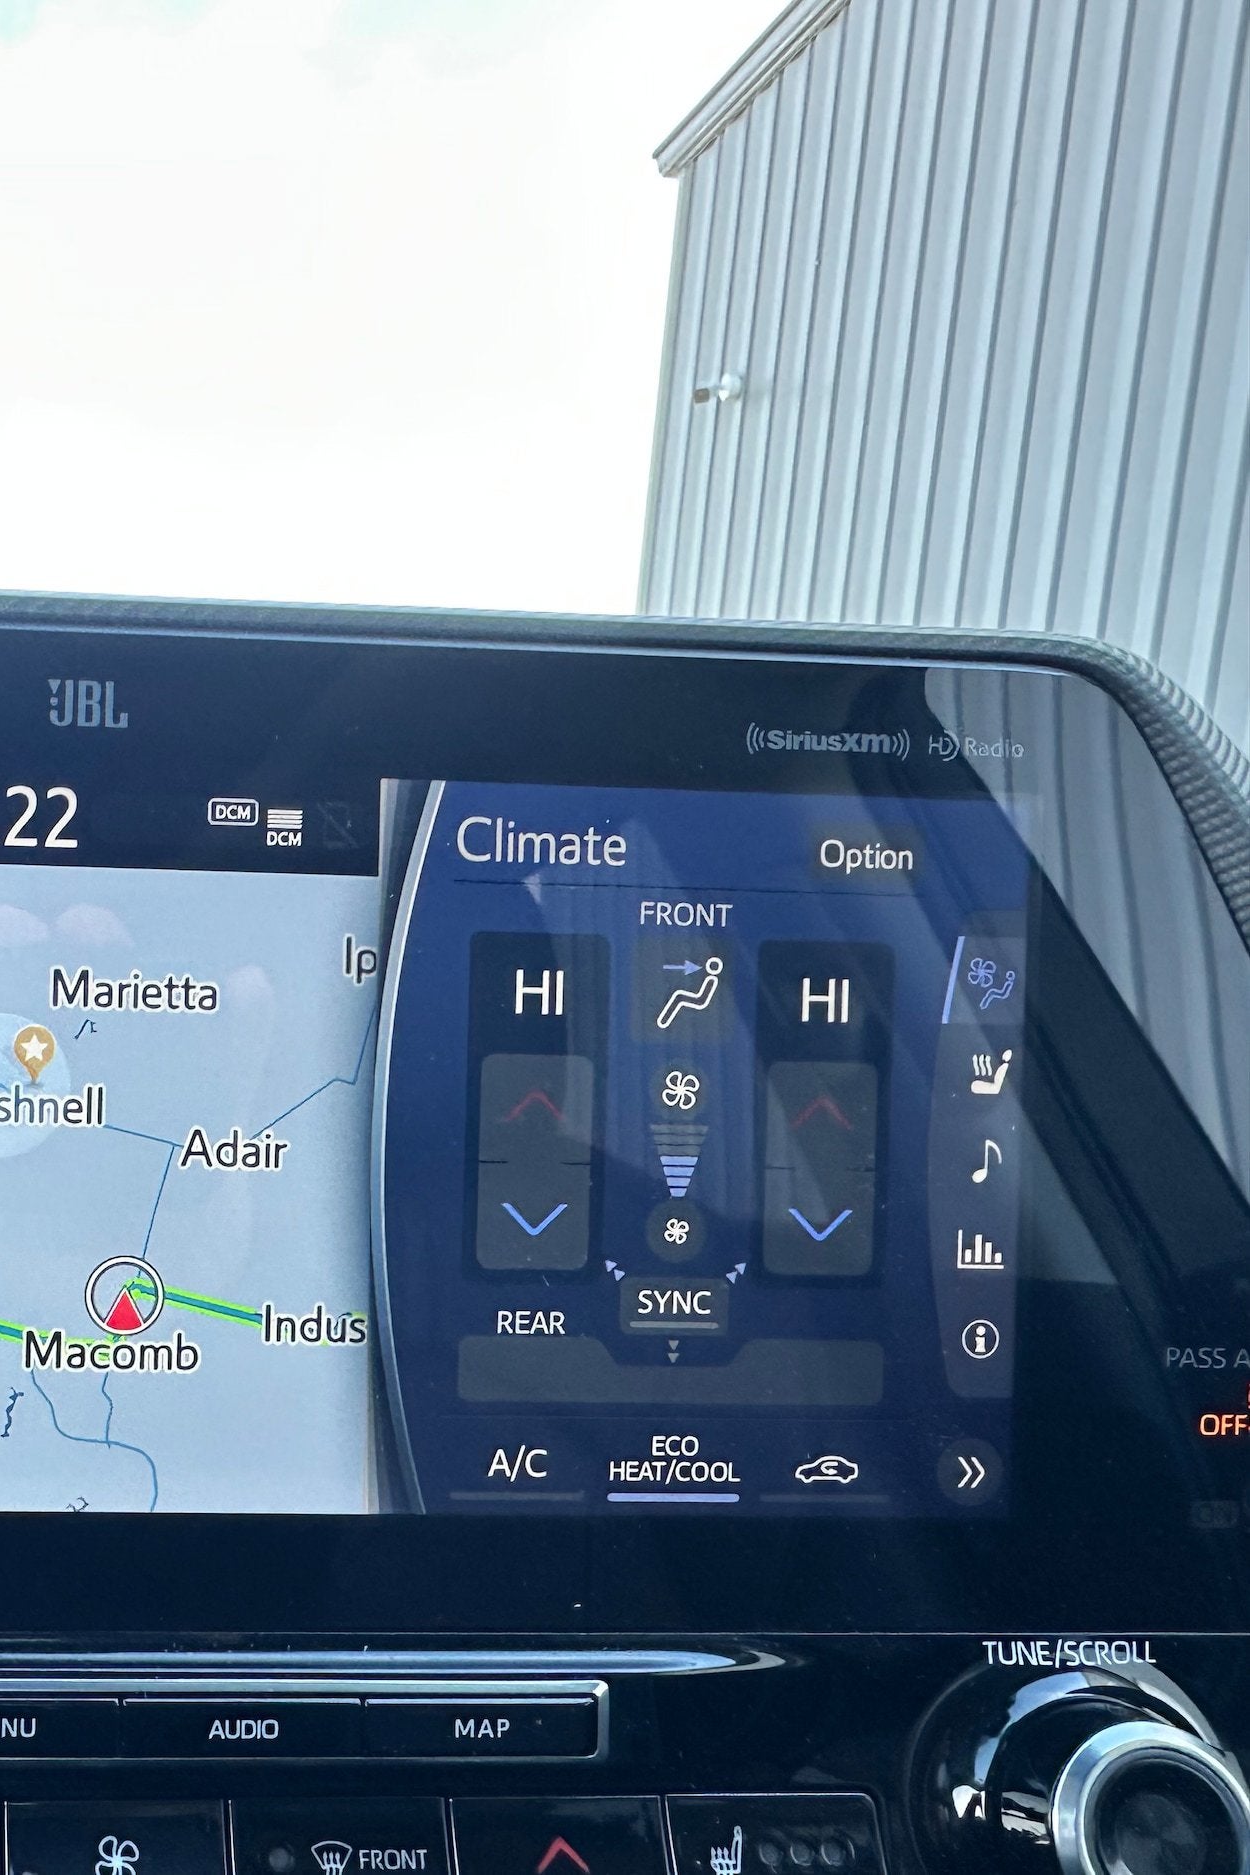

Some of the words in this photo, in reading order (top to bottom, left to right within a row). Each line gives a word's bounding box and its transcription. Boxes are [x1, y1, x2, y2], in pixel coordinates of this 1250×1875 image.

[48, 679, 128, 728] JBL
[966, 737, 1024, 757] Radio
[216, 805, 250, 819] DCM
[267, 831, 301, 846] DCM
[457, 817, 626, 866] Climate
[821, 840, 912, 874] Option
[641, 902, 733, 926] FRONT
[53, 969, 216, 1010] Marietta
[516, 970, 564, 1015] HI
[802, 978, 849, 1023] HI
[180, 1129, 287, 1169] Adair
[638, 1290, 711, 1314] SYNC
[265, 1304, 366, 1342] Indus
[498, 1311, 565, 1334] REAR
[25, 1331, 199, 1370] Macomb
[1166, 1347, 1226, 1369] PASS
[1200, 1415, 1247, 1435] OFF
[652, 1436, 698, 1456] ECO
[488, 1445, 547, 1482] A/C
[610, 1459, 740, 1484] HEAT/COOL
[982, 1639, 1157, 1667] TUNE/SCROLL
[209, 1720, 278, 1739] AUDIO
[455, 1719, 509, 1738] MAP
[359, 1850, 427, 1870] FRONT
